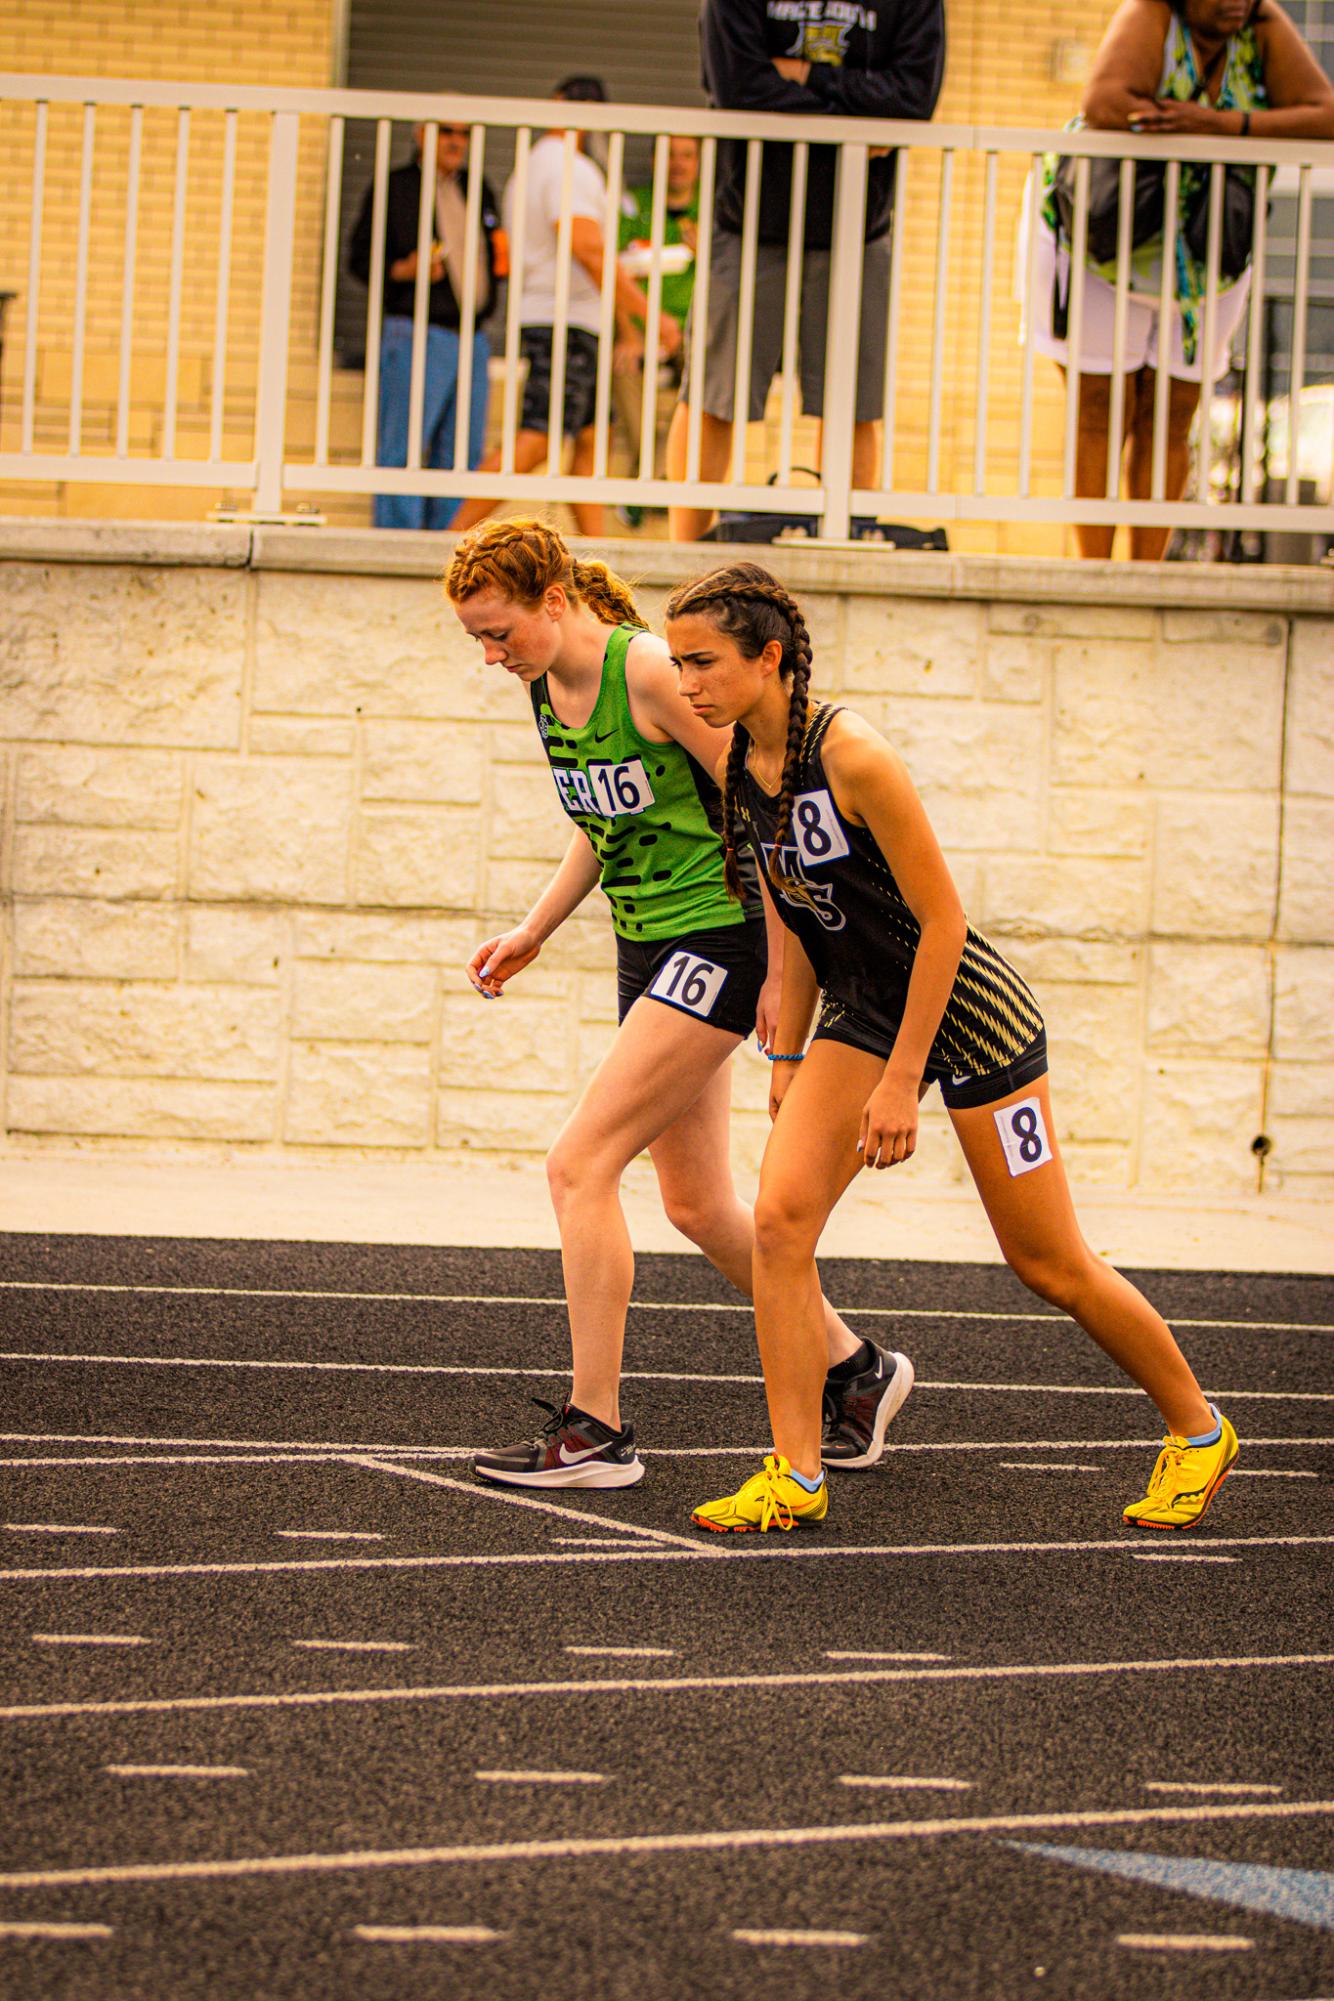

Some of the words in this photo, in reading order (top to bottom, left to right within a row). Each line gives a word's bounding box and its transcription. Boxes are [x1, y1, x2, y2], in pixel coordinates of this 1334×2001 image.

[598, 766, 640, 811] 16
[798, 801, 831, 856] 8
[666, 955, 714, 1006] 16
[1011, 1107, 1042, 1162] 8
